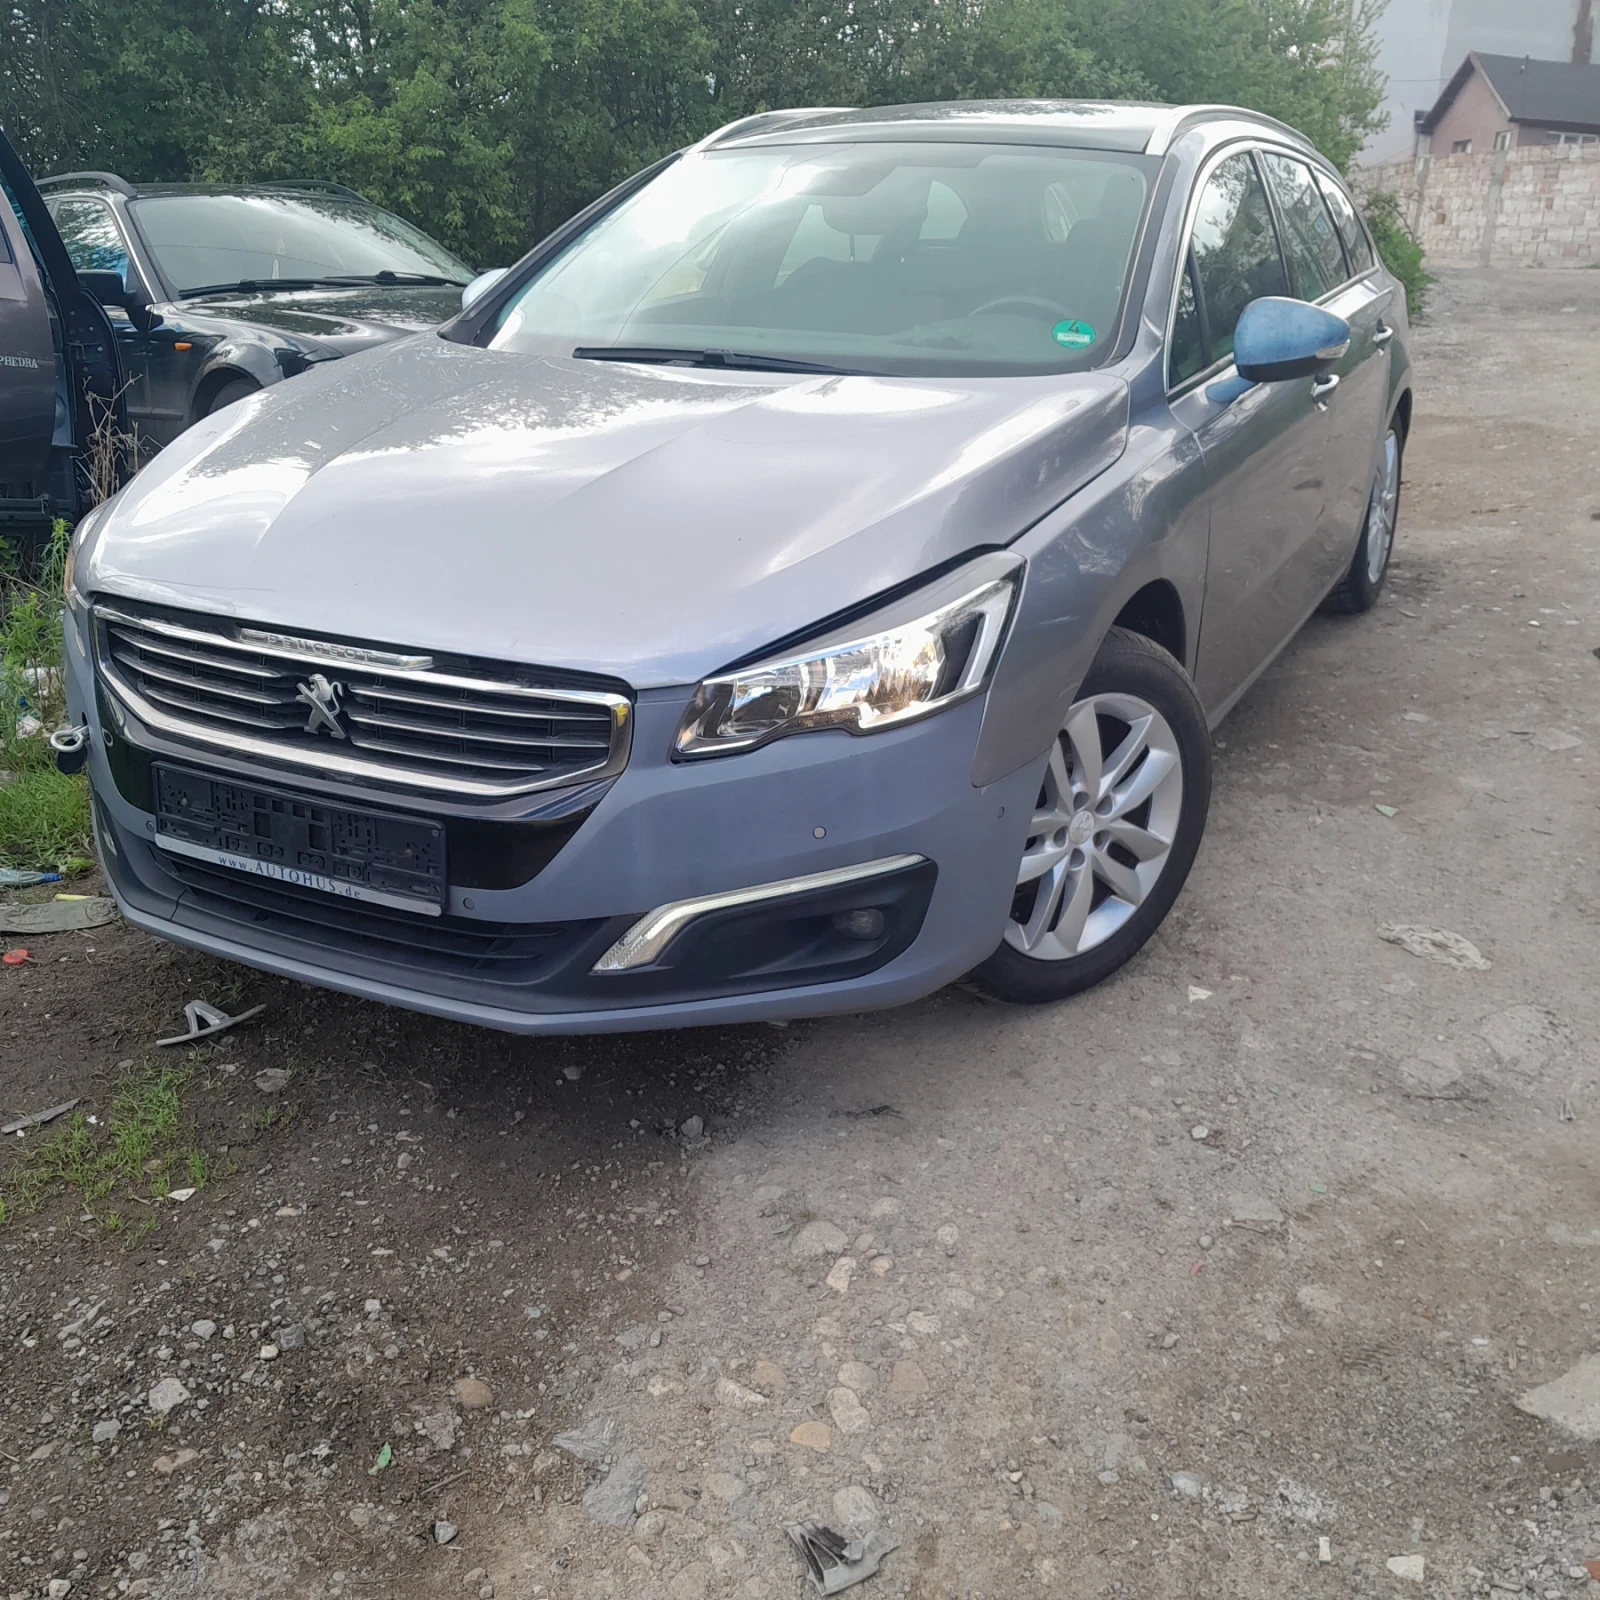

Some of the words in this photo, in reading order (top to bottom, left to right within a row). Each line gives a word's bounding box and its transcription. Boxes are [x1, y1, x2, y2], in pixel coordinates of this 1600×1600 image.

[1067, 320, 1080, 334] 4
[266, 634, 375, 661] PEUGEOT
[217, 855, 361, 899] www.AUTOHUS.de
